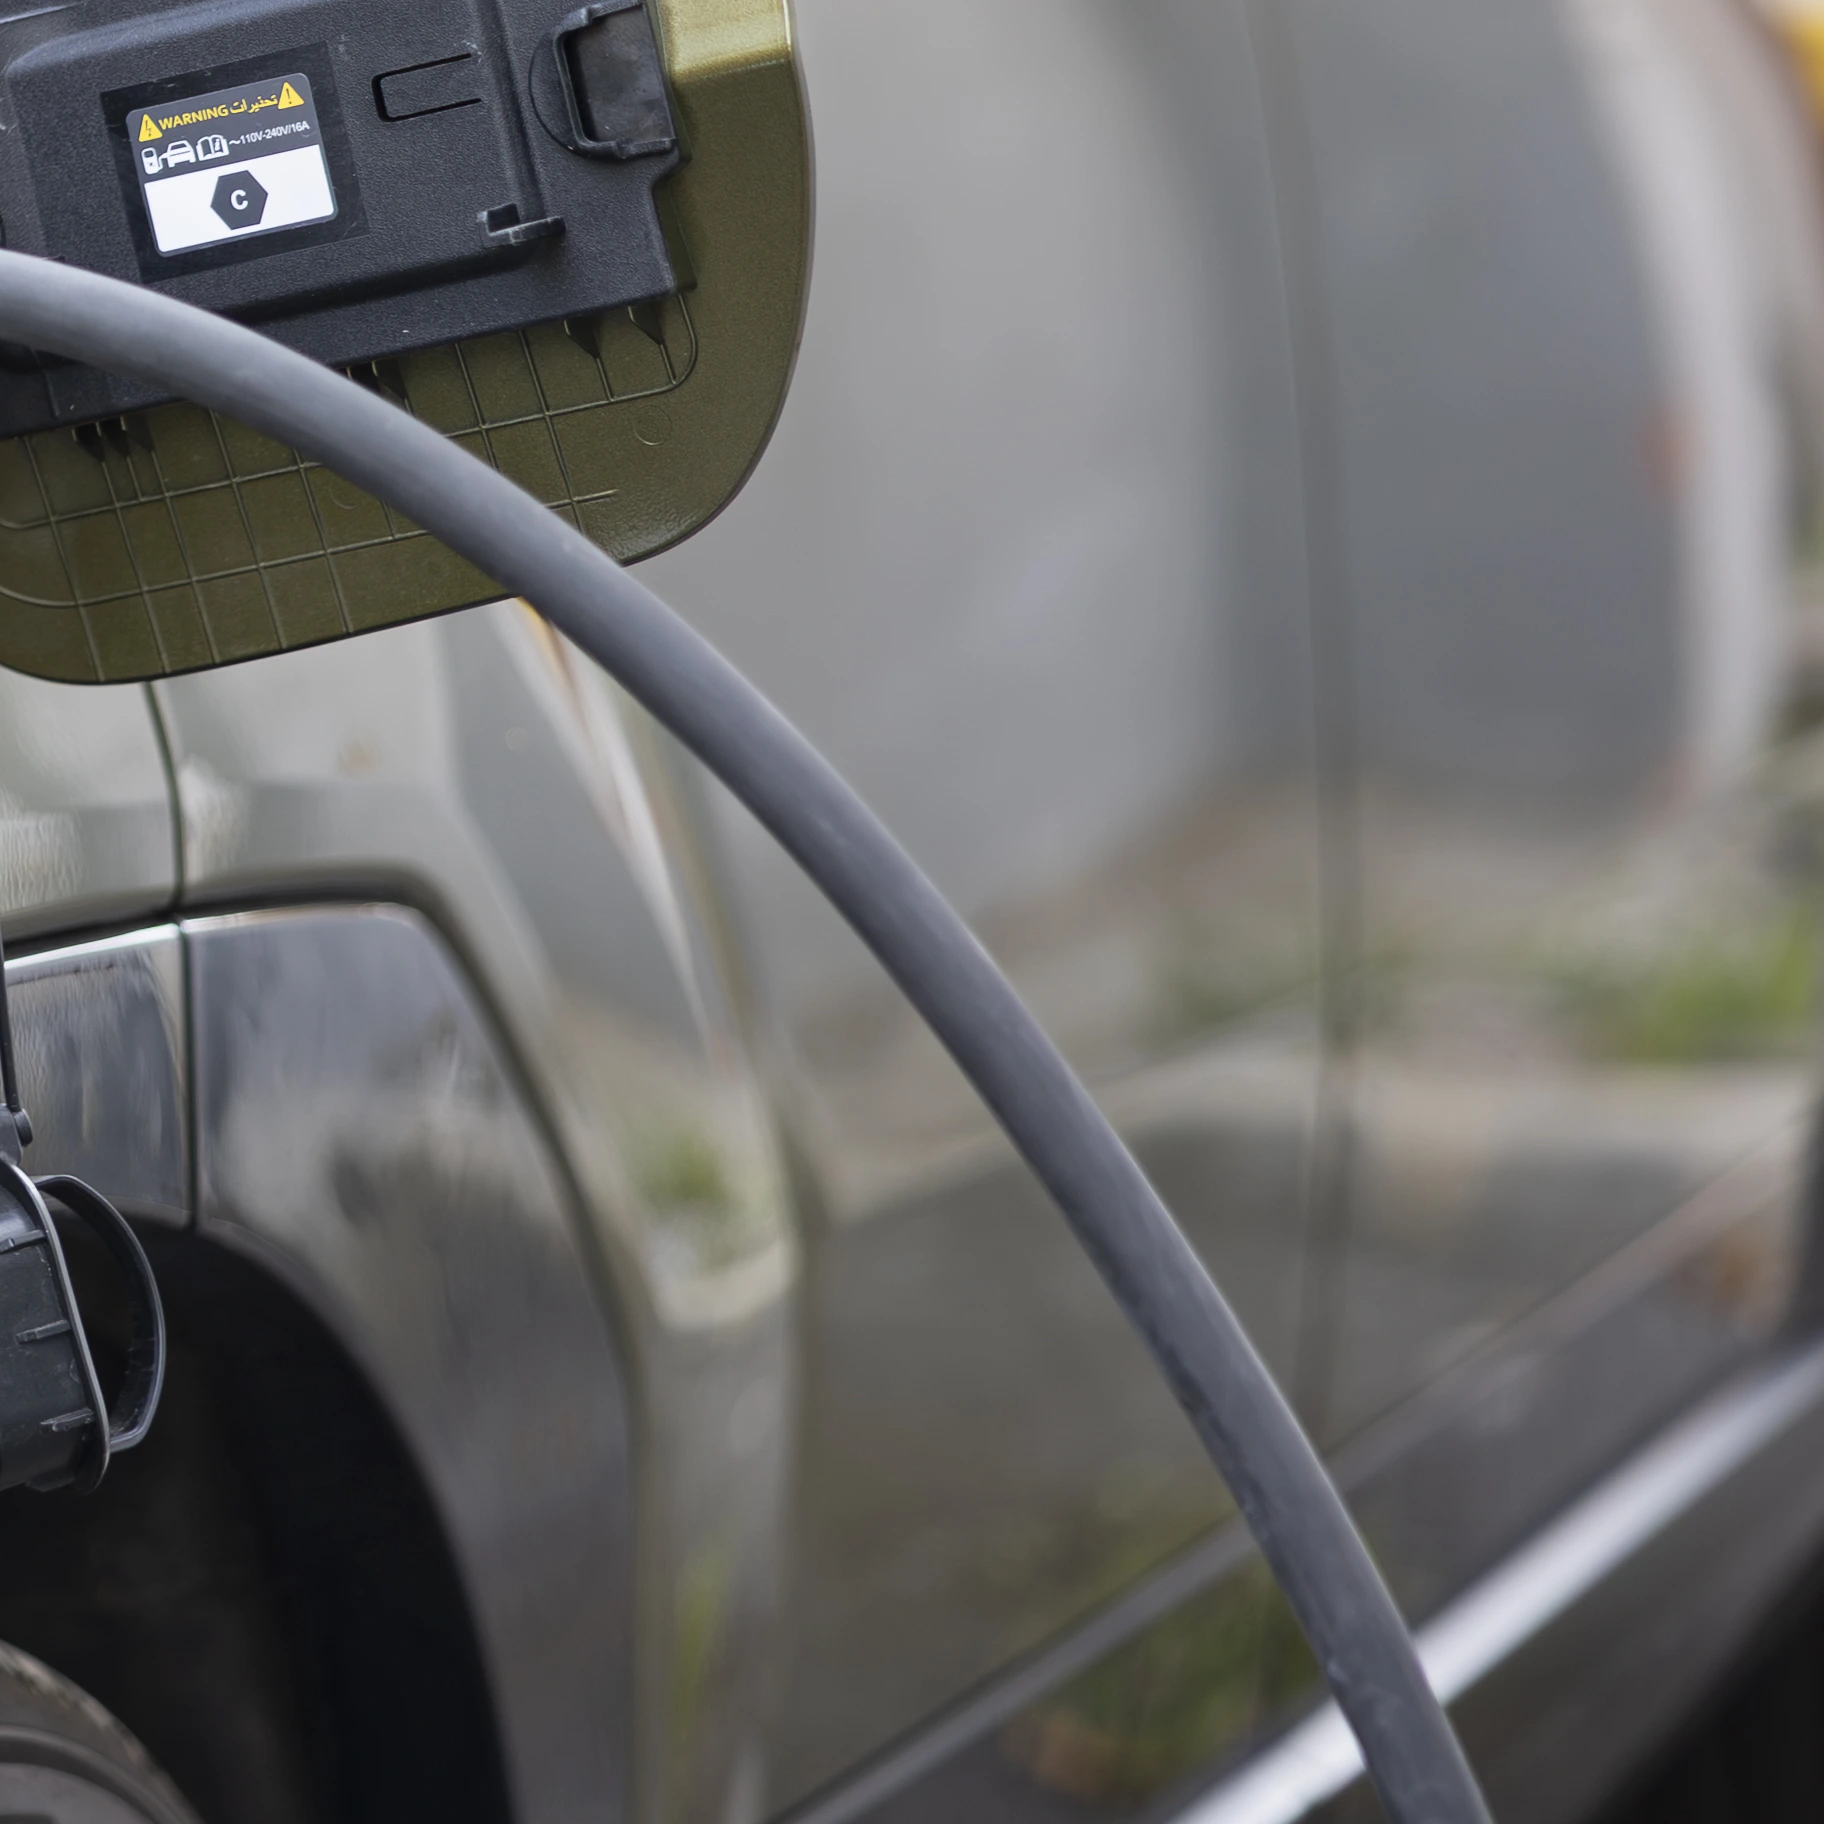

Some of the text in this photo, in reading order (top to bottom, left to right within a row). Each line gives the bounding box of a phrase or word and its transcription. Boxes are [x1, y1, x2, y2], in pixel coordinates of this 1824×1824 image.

[229, 93, 279, 115] تحذيرات
[158, 104, 229, 131] WARNING
[230, 189, 249, 211] C
